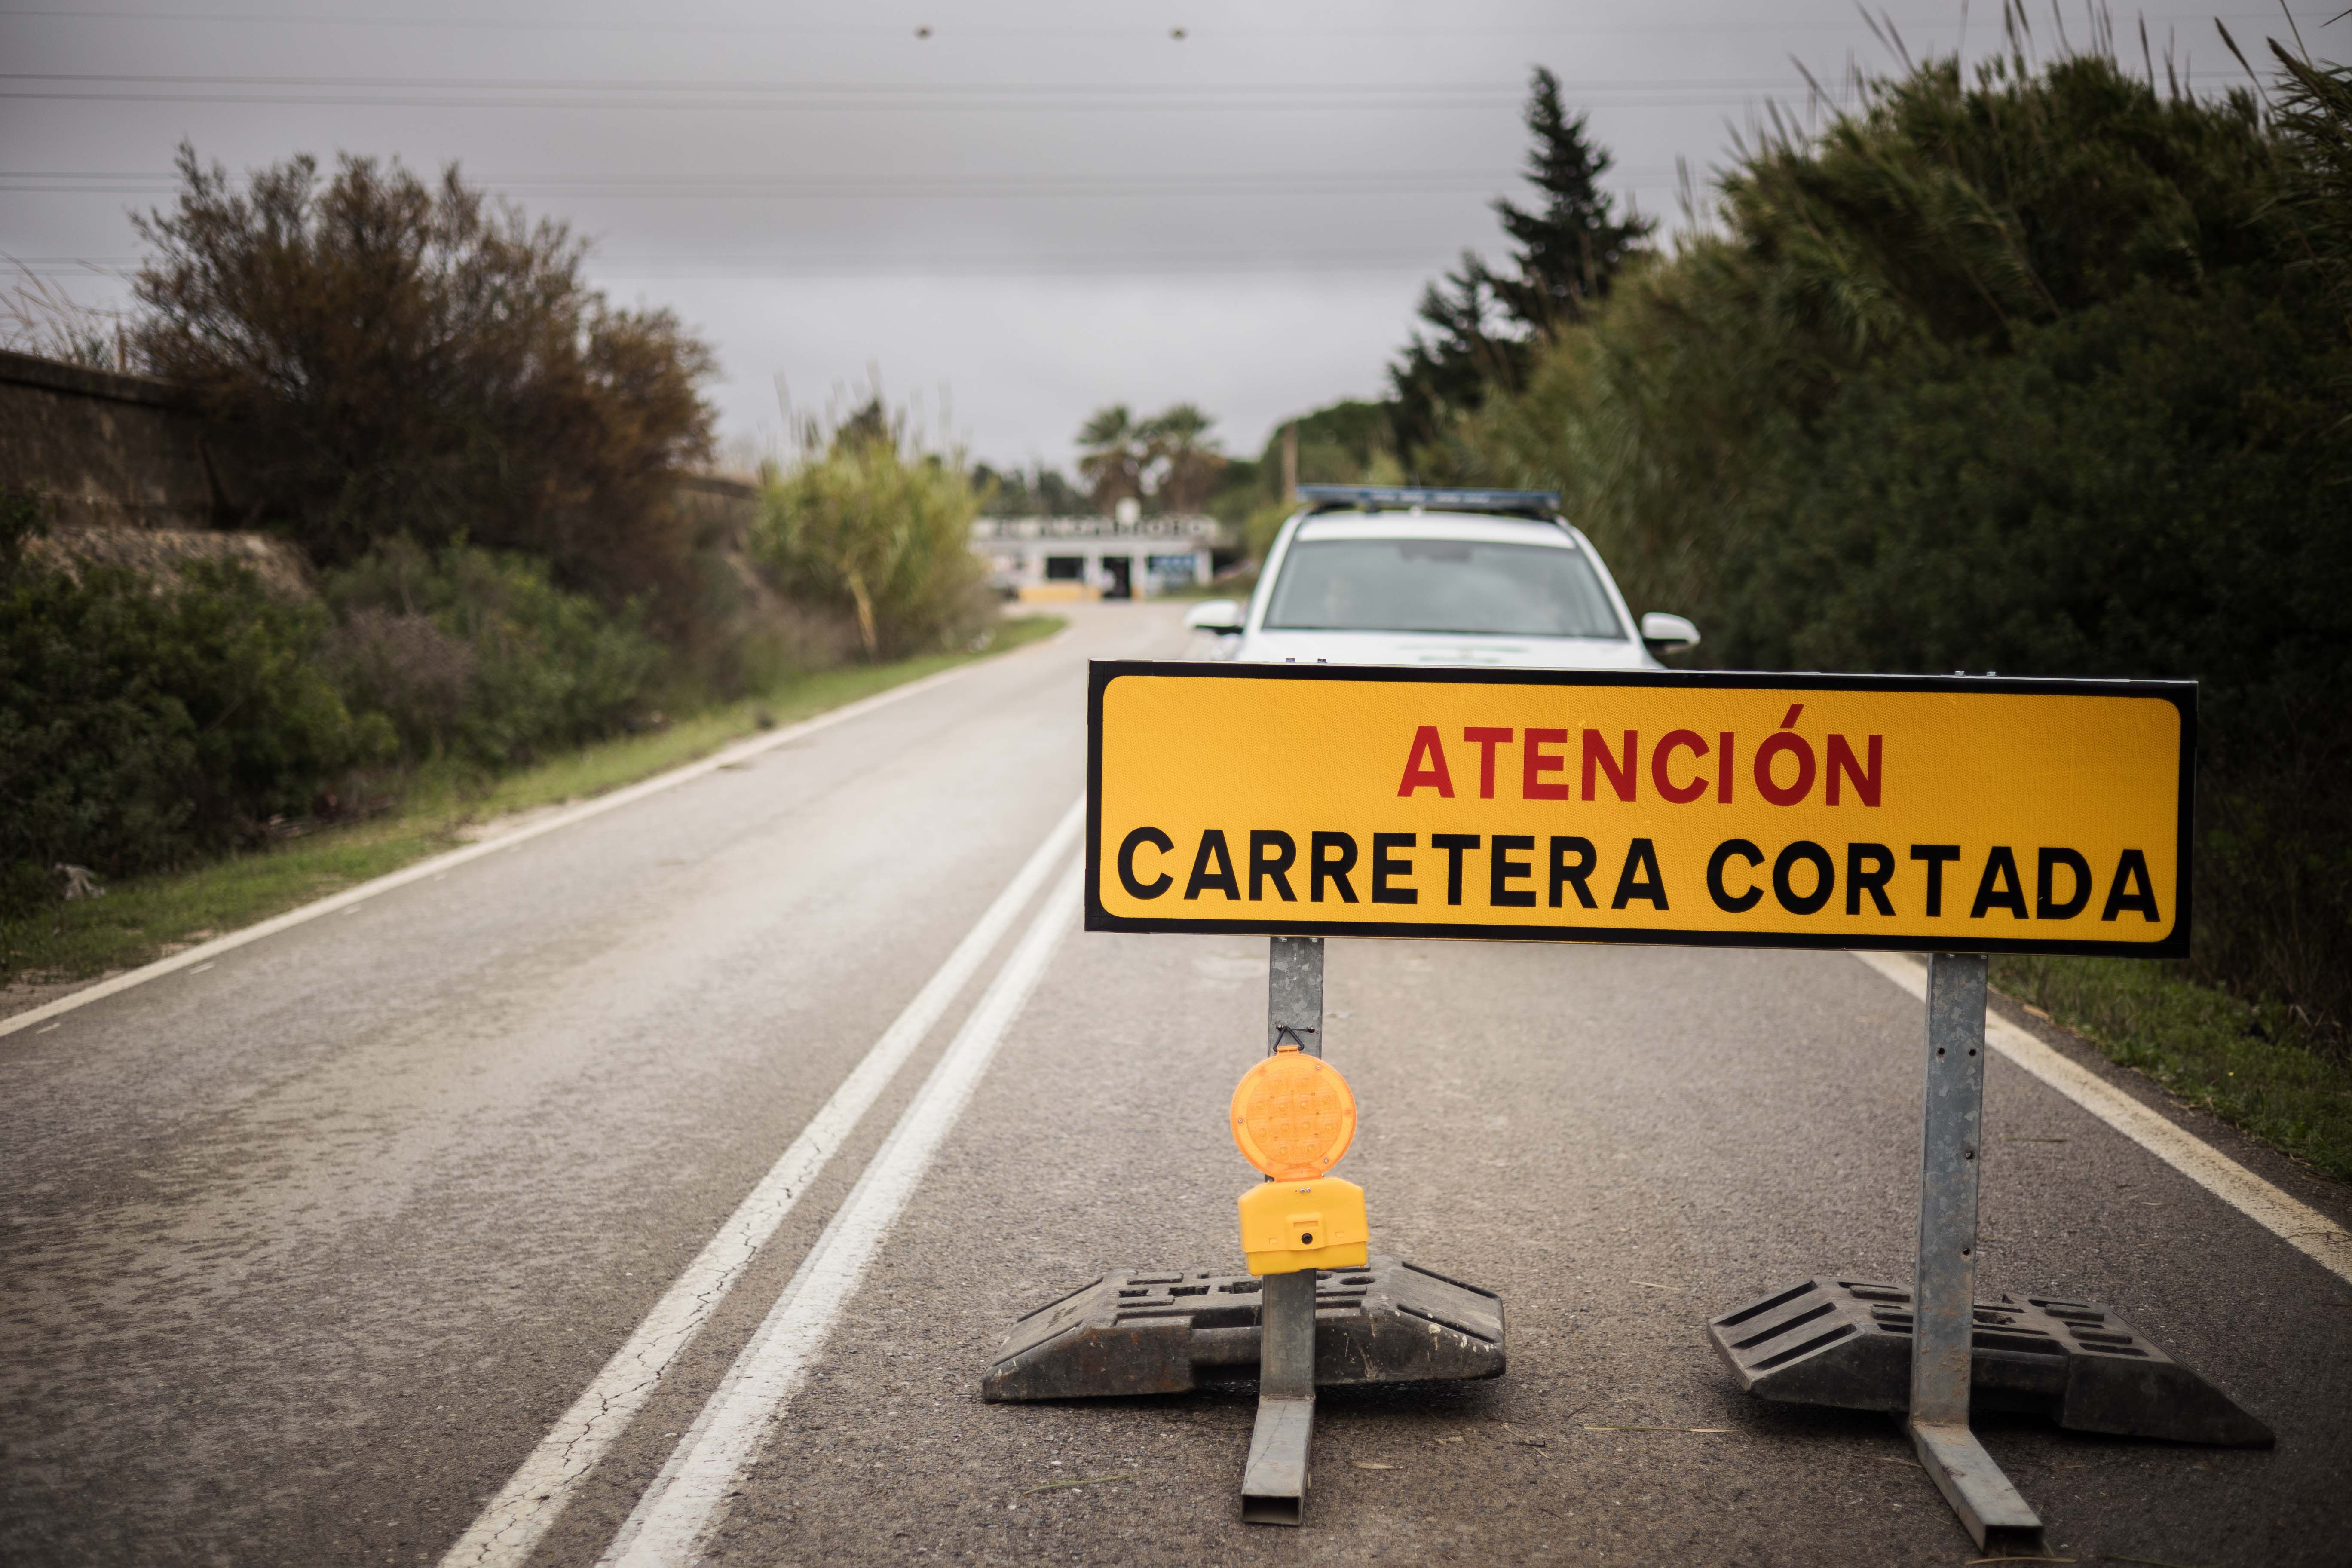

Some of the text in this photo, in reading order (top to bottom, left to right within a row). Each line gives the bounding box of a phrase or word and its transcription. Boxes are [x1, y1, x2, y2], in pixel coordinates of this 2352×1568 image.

[1398, 704, 1882, 807] ATENCIÓN
[1118, 827, 2160, 922] CARRETERA CORTADA
